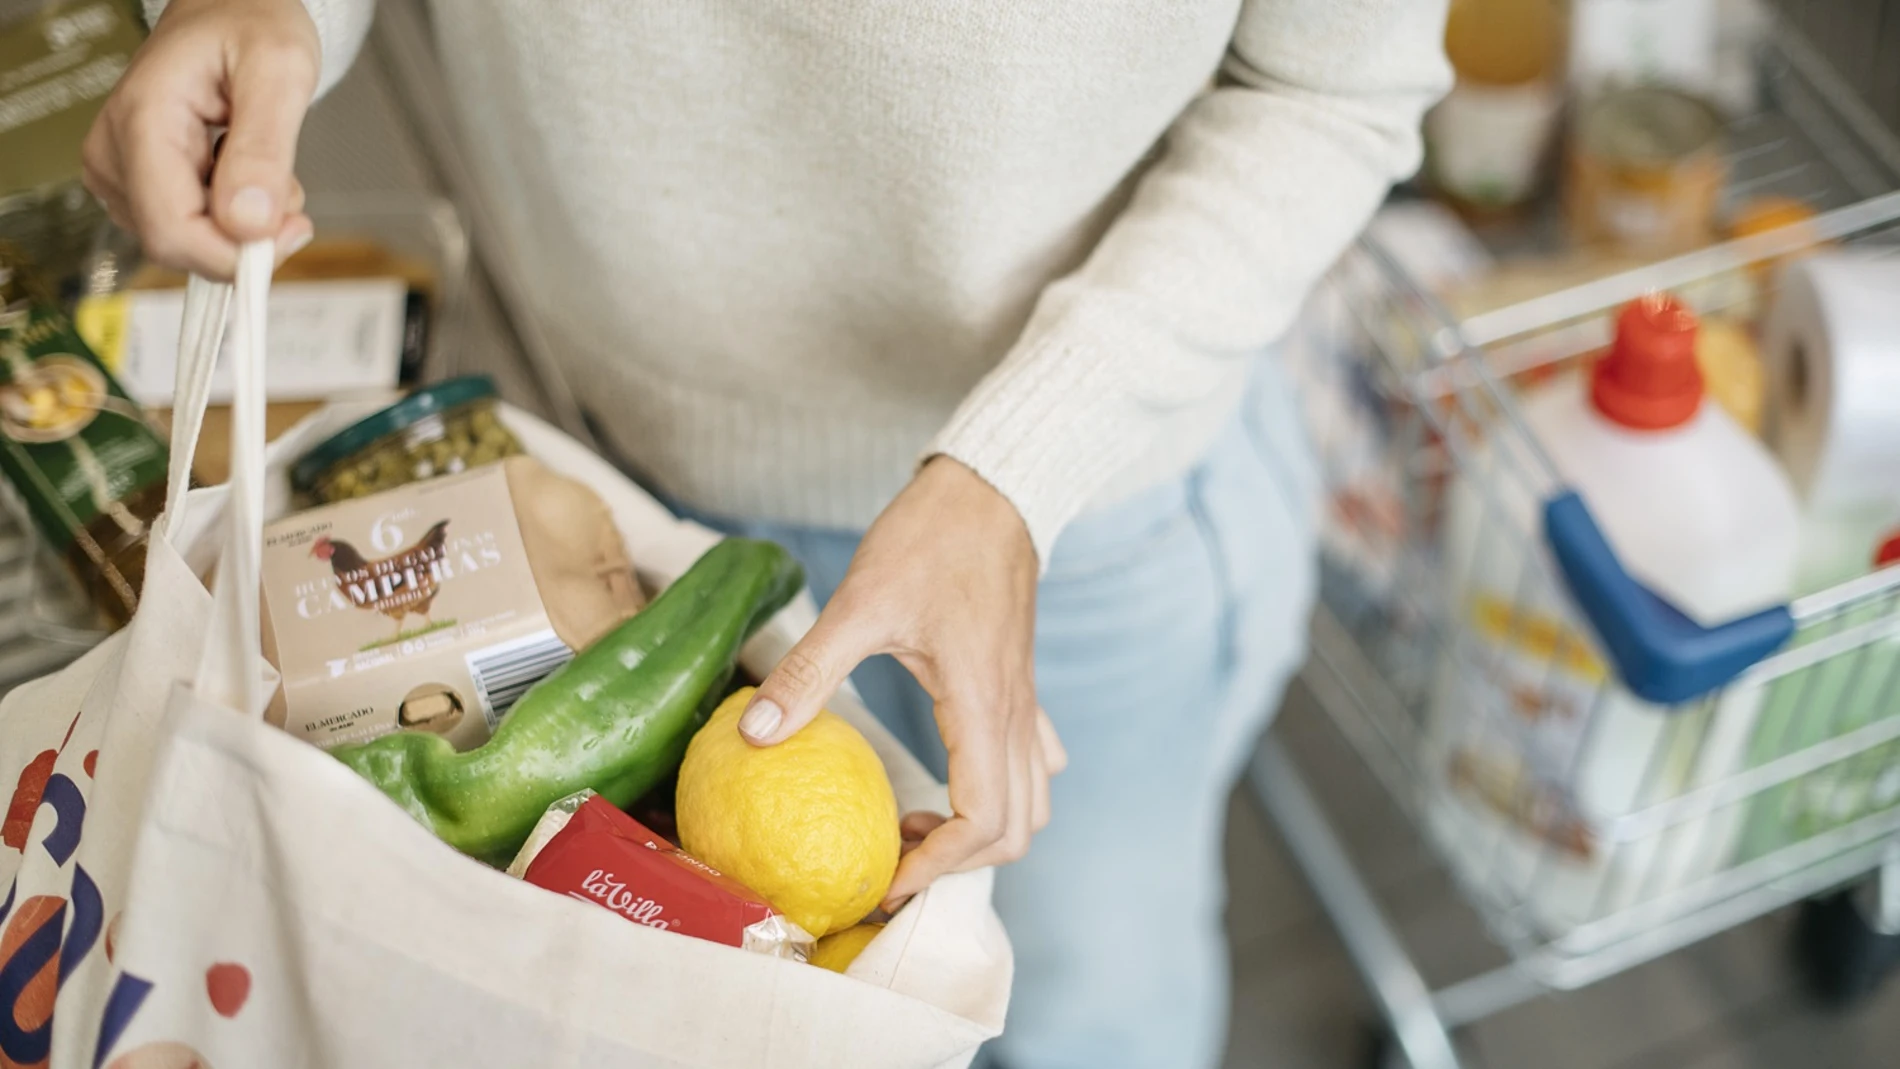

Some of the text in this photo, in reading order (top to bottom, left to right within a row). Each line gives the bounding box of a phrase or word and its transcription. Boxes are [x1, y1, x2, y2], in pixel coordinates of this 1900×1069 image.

[295, 531, 496, 598] HUEVOS DE GALLINAS
[371, 514, 404, 553] 6
[296, 545, 502, 619] CAMPERAS
